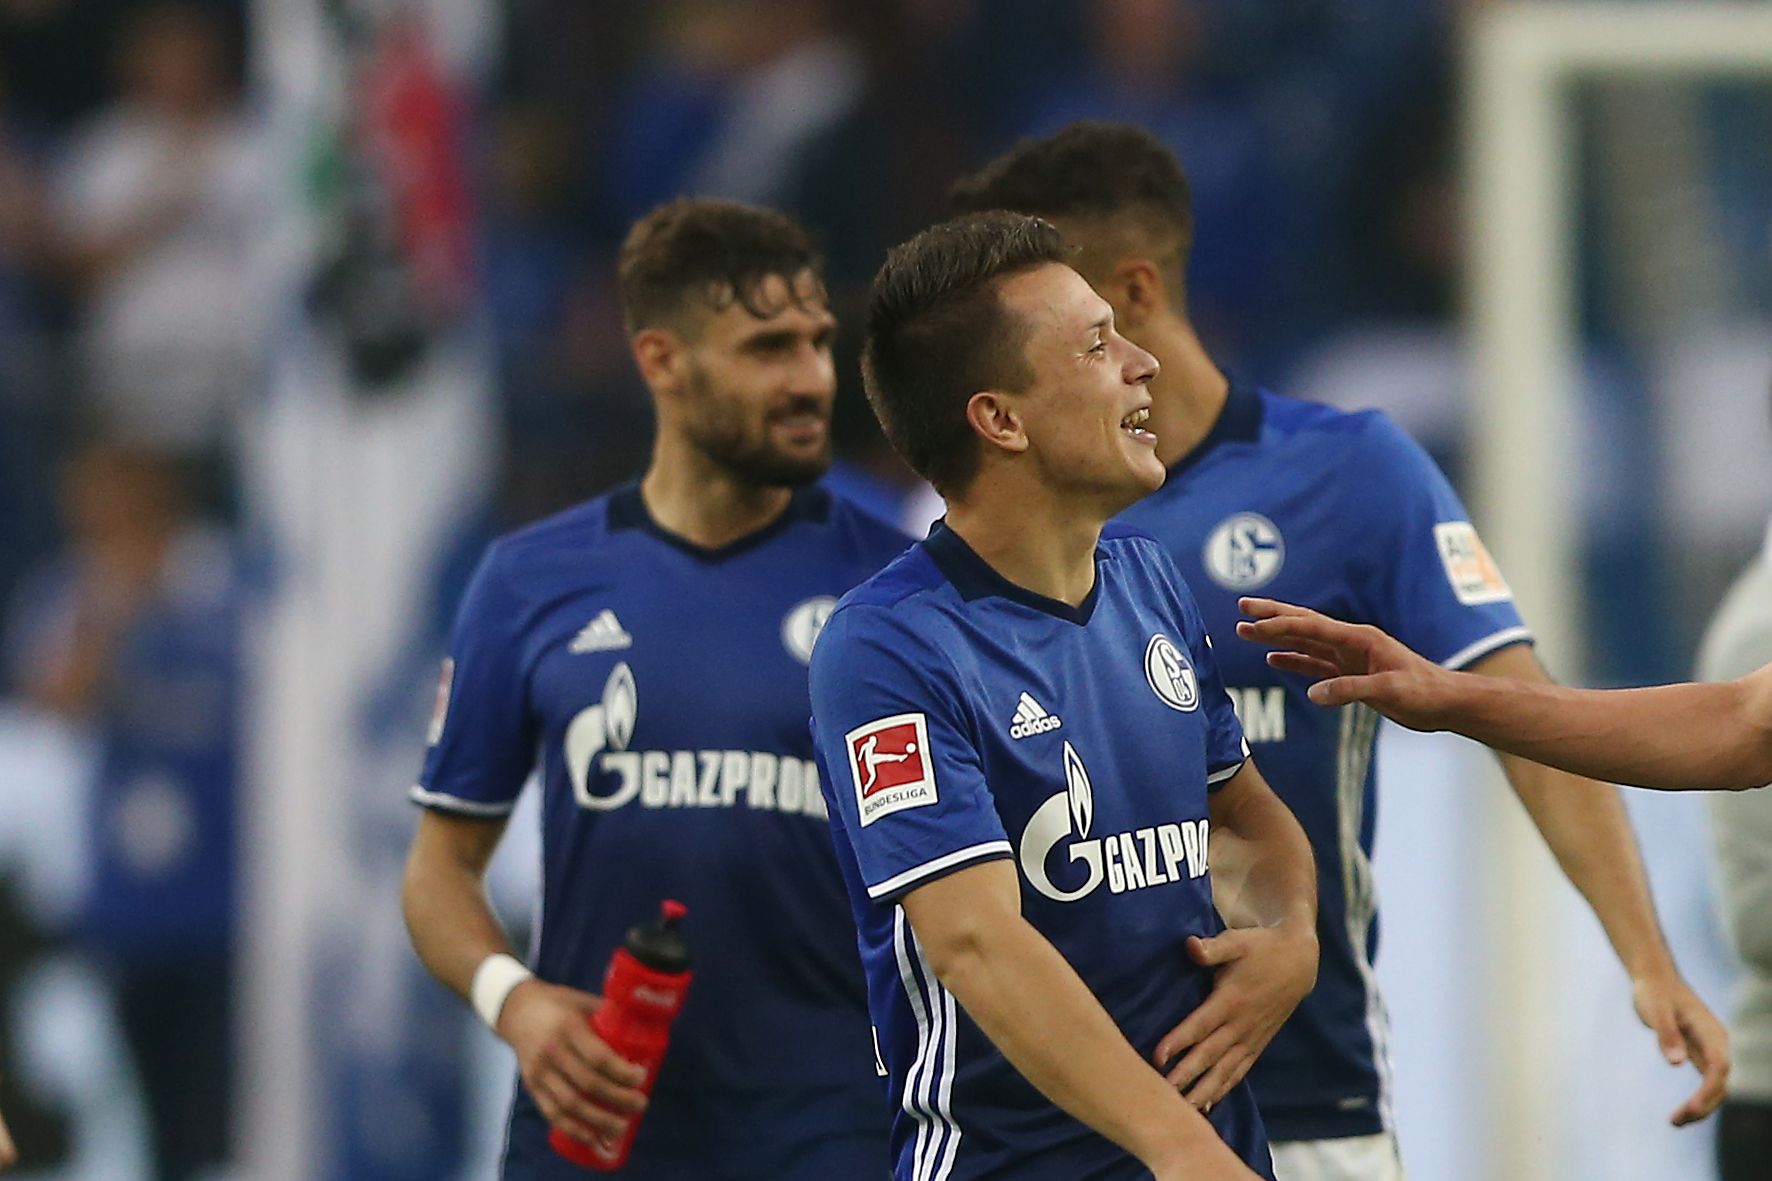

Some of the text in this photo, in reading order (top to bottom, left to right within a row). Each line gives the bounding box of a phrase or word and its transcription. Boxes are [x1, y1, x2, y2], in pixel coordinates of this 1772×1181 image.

[1010, 715, 1061, 739] adidas
[864, 787, 928, 816] BUNDESLIGA
[1105, 819, 1210, 894] GAZPRO
